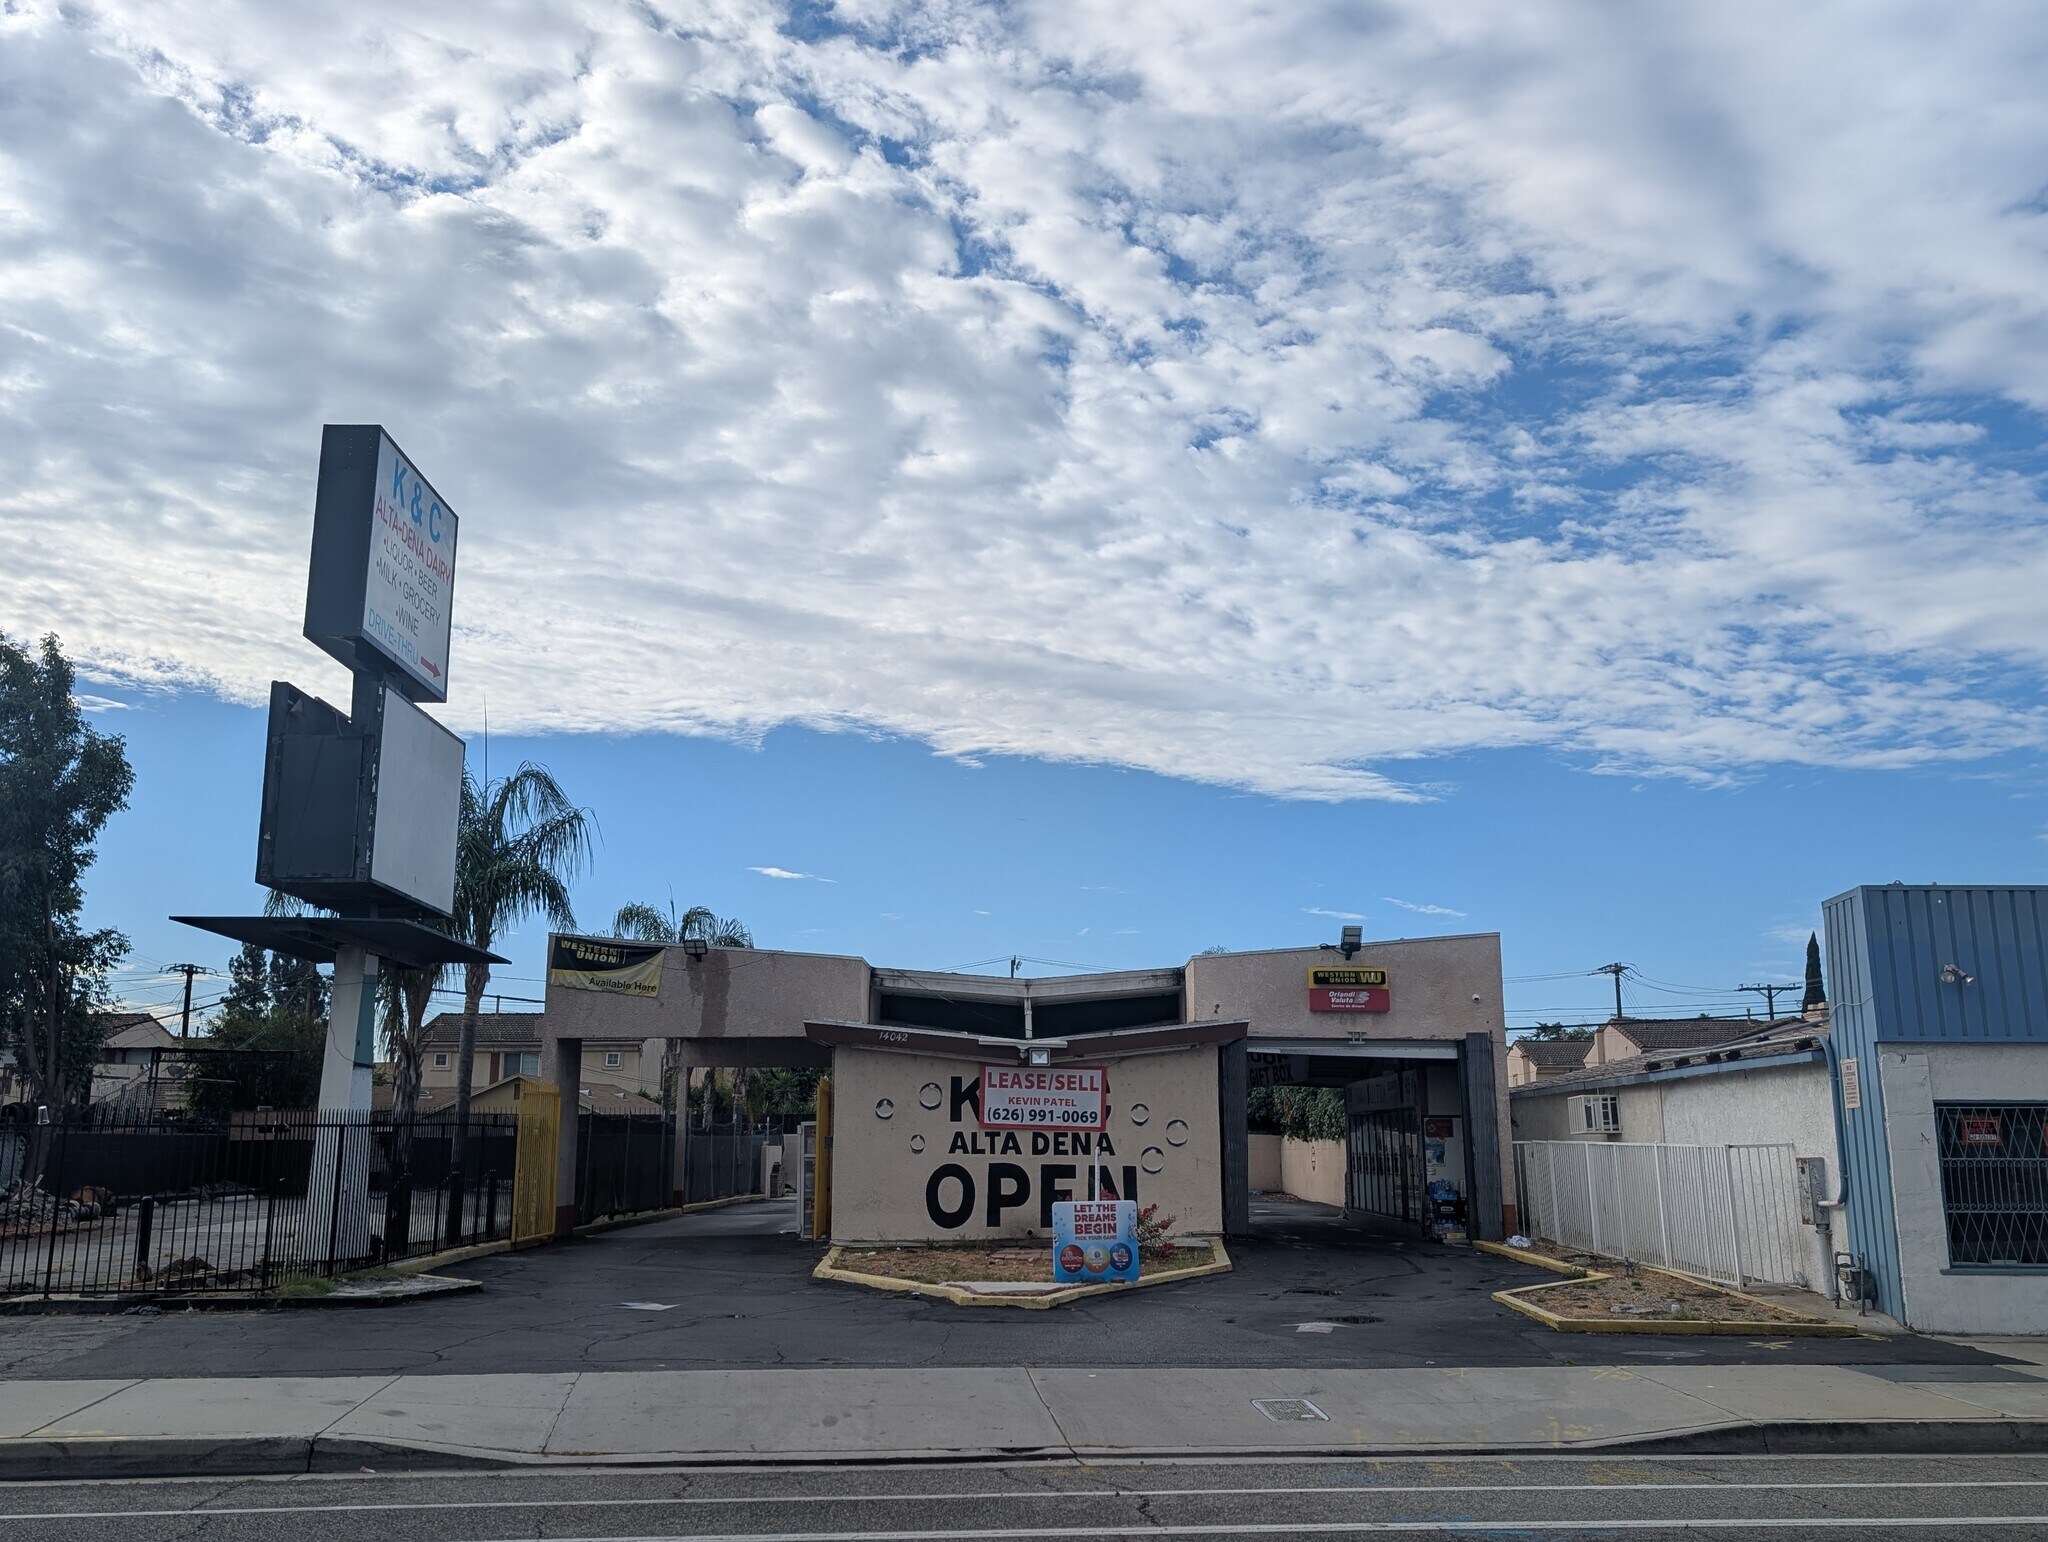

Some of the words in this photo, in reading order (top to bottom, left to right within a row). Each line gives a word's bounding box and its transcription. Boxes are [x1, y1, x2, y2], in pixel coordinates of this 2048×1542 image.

[393, 457, 408, 510] K
[411, 482, 423, 528] &
[429, 501, 443, 544] C
[376, 494, 425, 563] ALTA-DENA
[426, 546, 451, 587] DAIRY
[386, 535, 414, 577] LIQUOR
[418, 571, 438, 600] BEER
[378, 558, 397, 590] MILK
[403, 584, 441, 627] GROCERY
[398, 604, 419, 638] WINE
[369, 607, 419, 666] DRIVE-THRU
[560, 939, 618, 955] WESTERN
[576, 950, 617, 963] UNION
[589, 977, 632, 990] Available
[634, 982, 657, 993] Here
[1359, 971, 1382, 983] WU
[878, 1031, 909, 1042] 14042
[987, 1071, 1100, 1092] LEASE/SELL
[1250, 1066, 1269, 1086] GIFT
[1272, 1063, 1293, 1083] BOX
[1008, 1096, 1041, 1105] KEVIN
[1043, 1098, 1077, 1107] PATEL
[987, 1107, 1024, 1123] (626)
[1028, 1109, 1098, 1124] 991-0069
[948, 1131, 1022, 1155] ALTA
[1031, 1131, 1116, 1156] DENA
[1074, 1204, 1093, 1213] LET
[1096, 1203, 1116, 1212] THE
[1074, 1213, 1117, 1222] DREAMS
[1074, 1222, 1117, 1234] BEGIN
